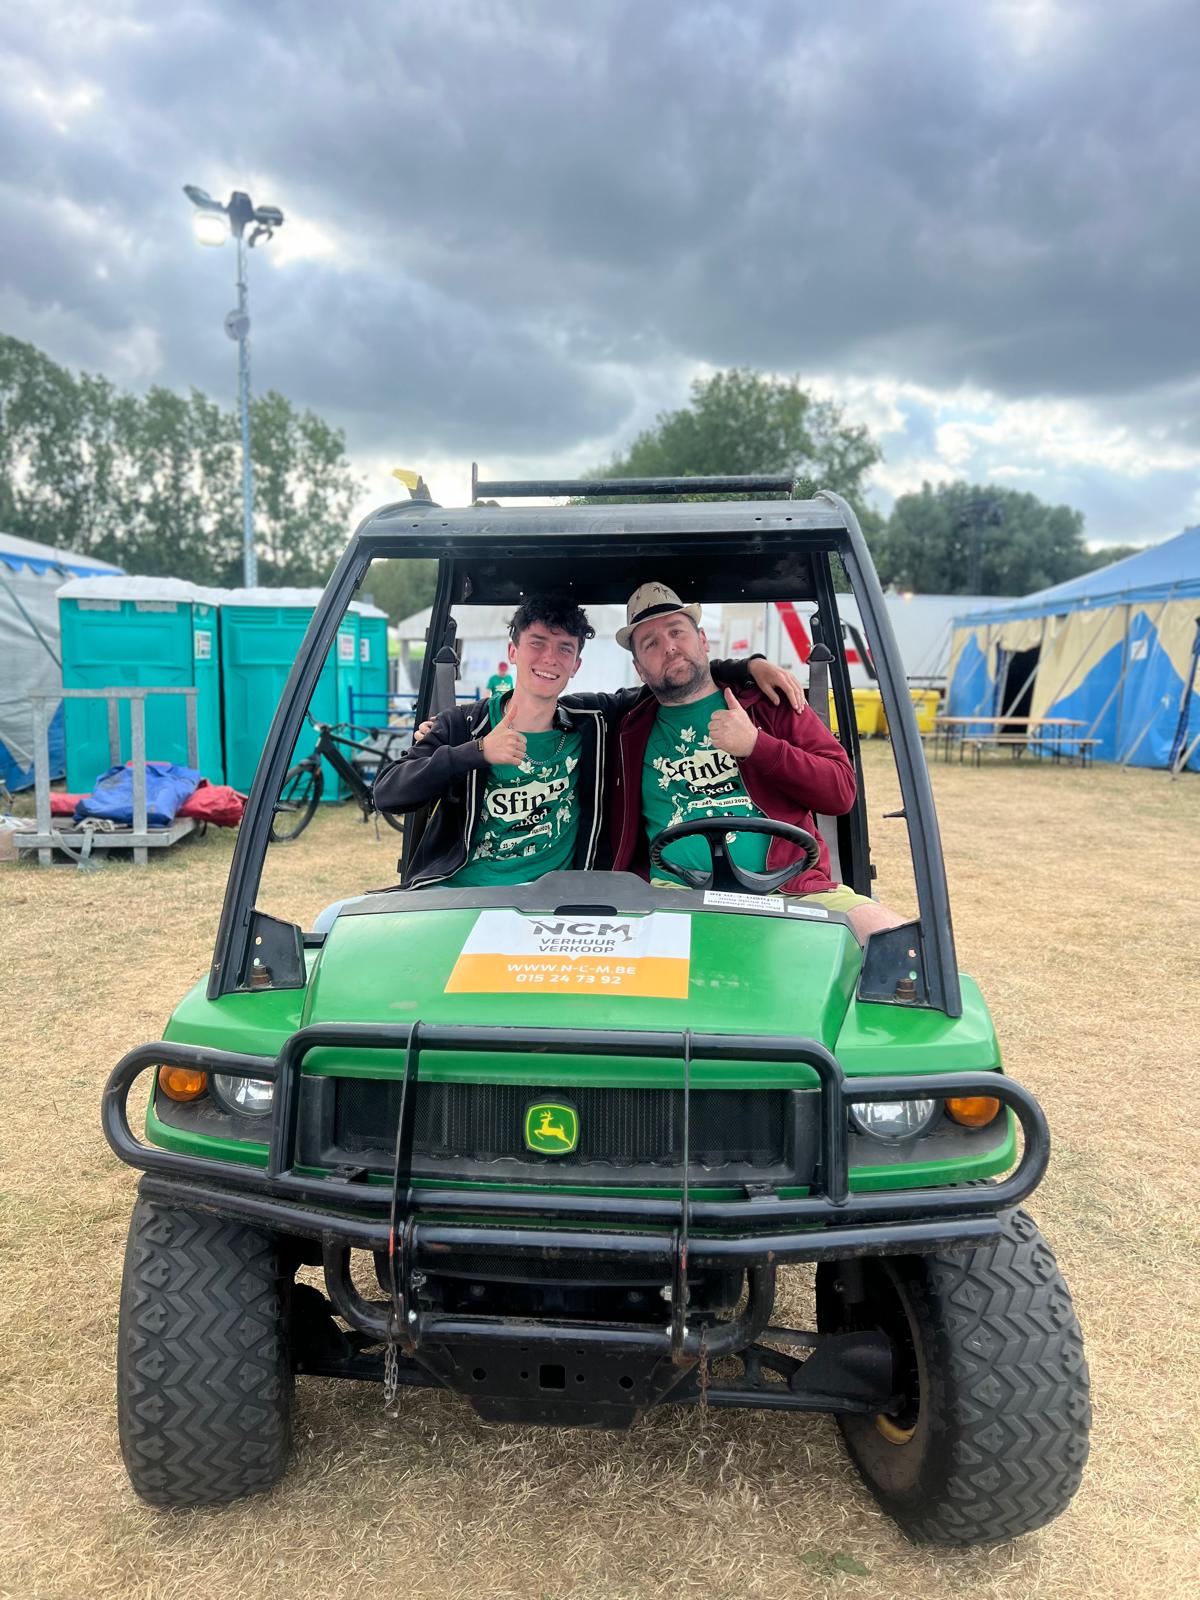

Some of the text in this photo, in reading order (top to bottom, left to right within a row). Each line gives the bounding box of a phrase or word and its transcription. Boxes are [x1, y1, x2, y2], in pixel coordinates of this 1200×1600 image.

[512, 808, 549, 829] ixed
[528, 919, 632, 941] NCM
[541, 938, 616, 946] VERHUUR
[539, 945, 614, 953] VERKOOP
[507, 964, 637, 975] WWW.N-C-M.BE
[515, 974, 622, 985] 015 24 73 92
